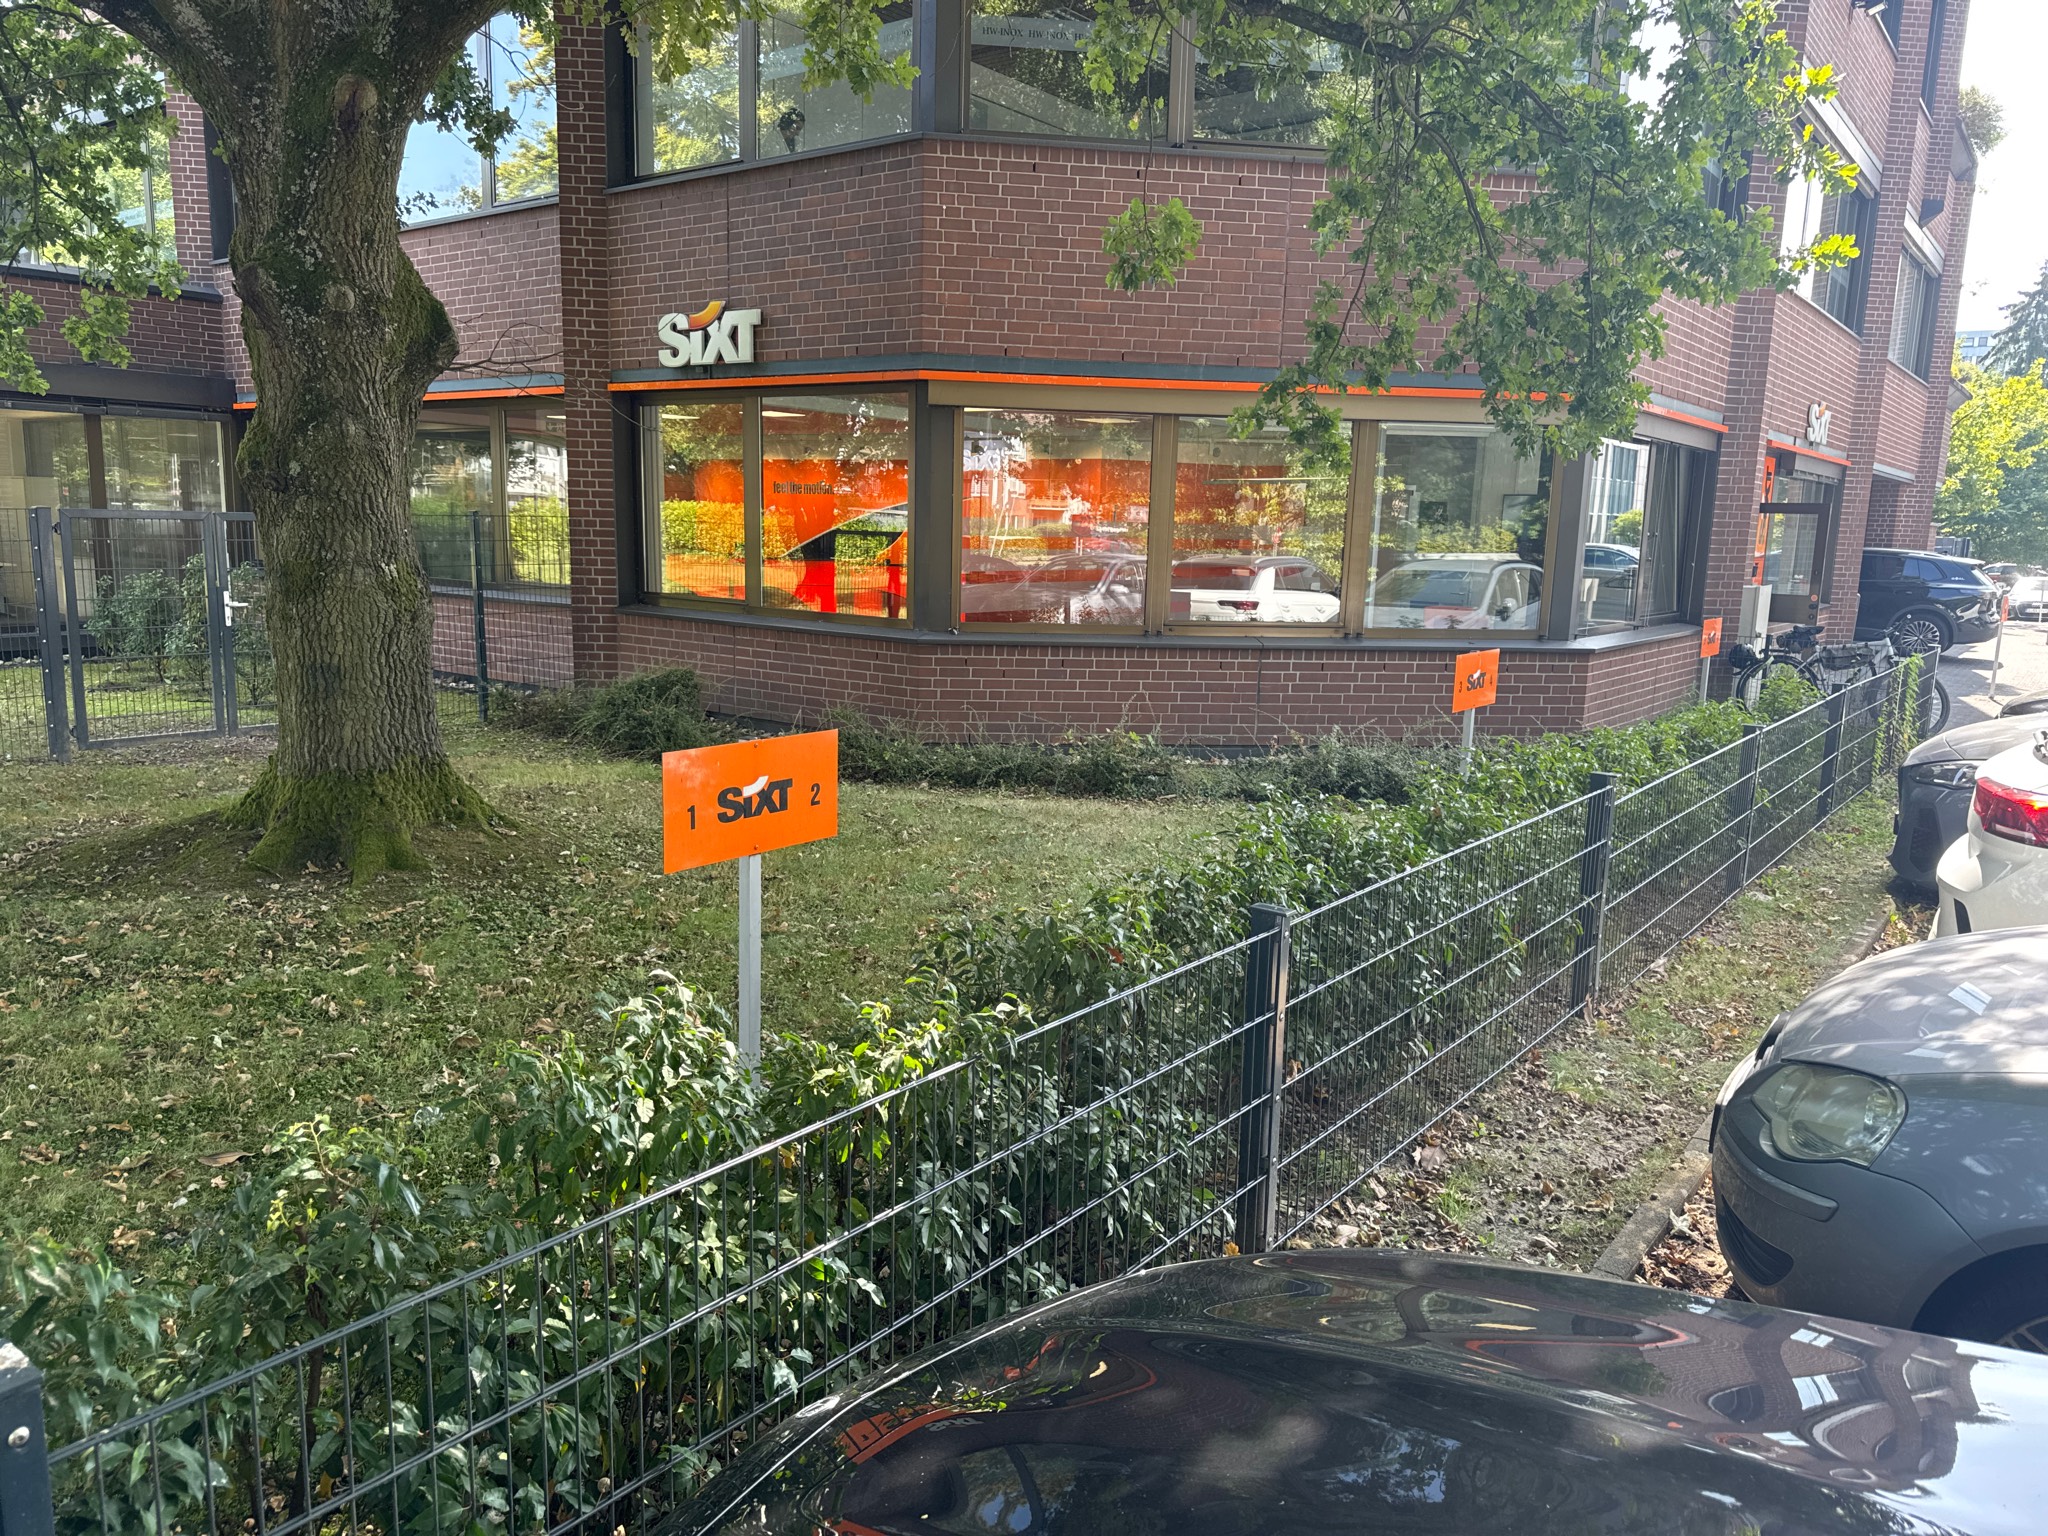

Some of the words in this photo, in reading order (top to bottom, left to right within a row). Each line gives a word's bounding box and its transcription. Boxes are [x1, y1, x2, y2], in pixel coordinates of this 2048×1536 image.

[982, 26, 1024, 37] HW-INOX
[1028, 29, 1069, 41] HW-INOX
[658, 300, 761, 368] SIXT
[1807, 401, 1831, 445] SIXT
[773, 481, 788, 494] feel
[789, 481, 802, 494] the
[1466, 669, 1486, 692] SIXT
[687, 805, 696, 830] 1
[717, 775, 793, 824] SIXT
[810, 783, 821, 806] 2
